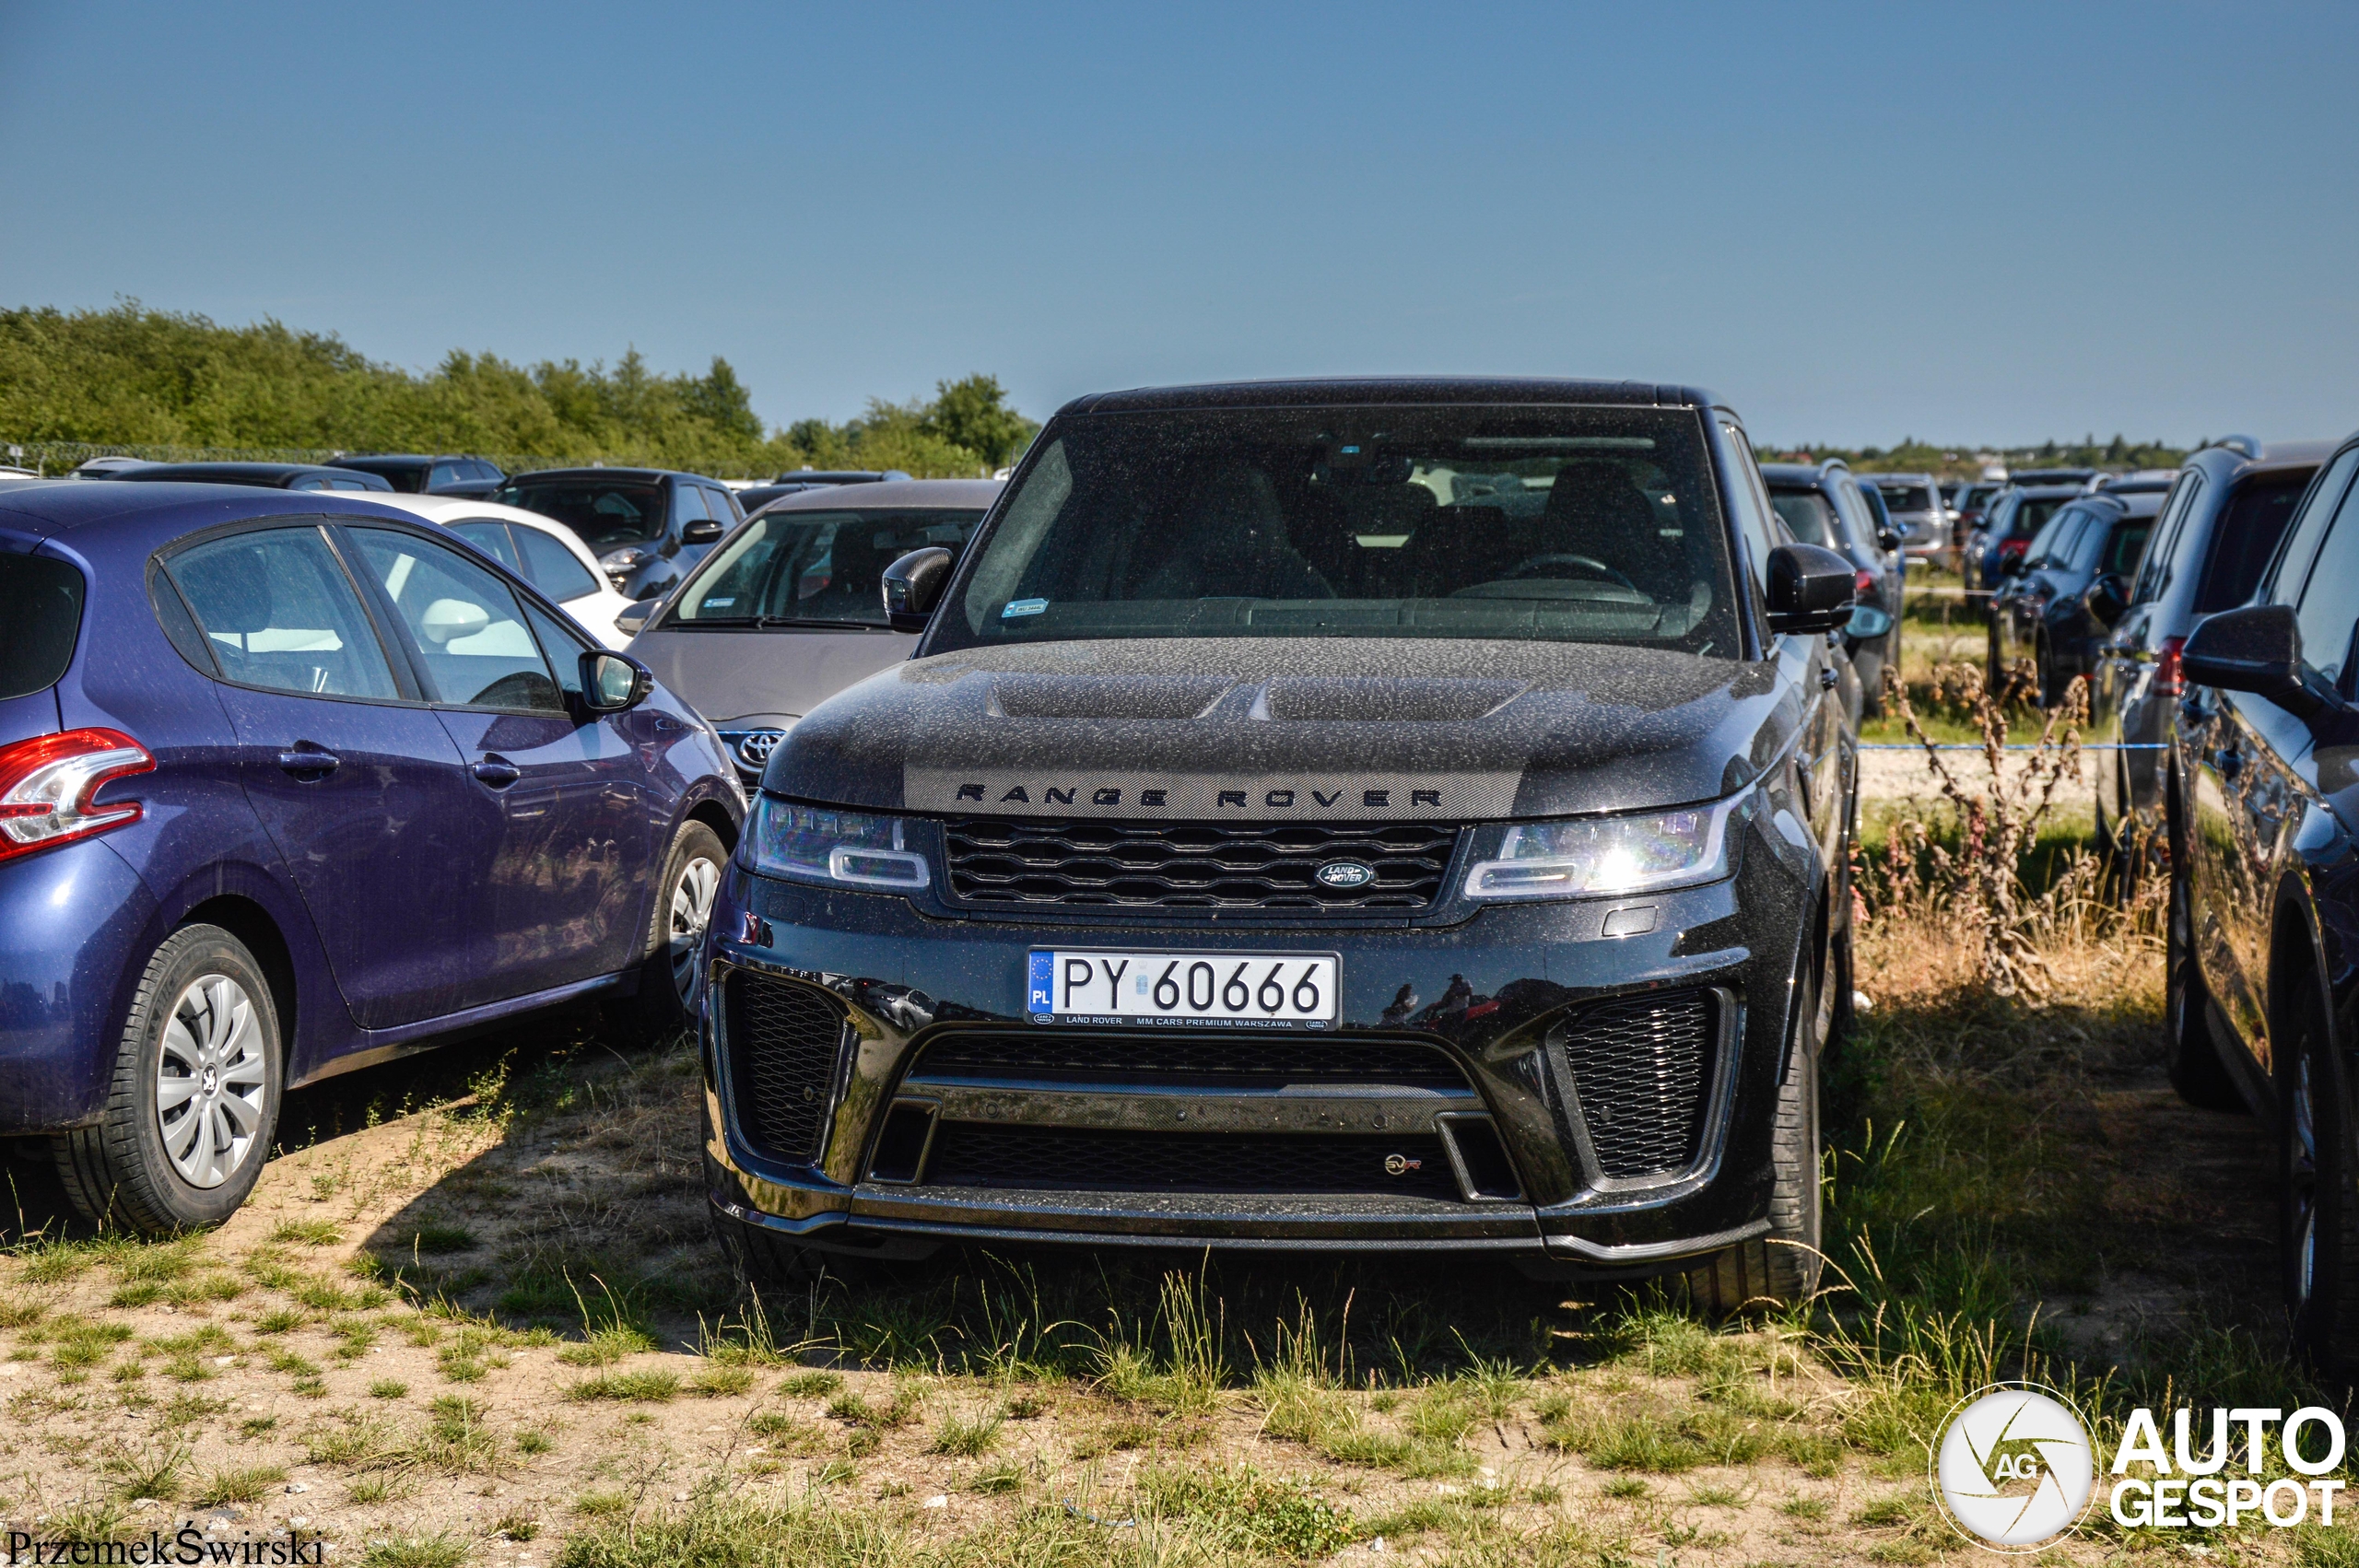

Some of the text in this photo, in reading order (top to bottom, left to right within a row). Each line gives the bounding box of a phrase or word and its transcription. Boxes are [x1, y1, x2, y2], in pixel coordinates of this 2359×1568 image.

[957, 784, 1442, 808] RANGE ROVER
[1328, 866, 1354, 874] LAND
[1065, 958, 1320, 1013] PY 60666
[1032, 989, 1050, 1004] PL
[1235, 1020, 1293, 1028] WARSZAWA
